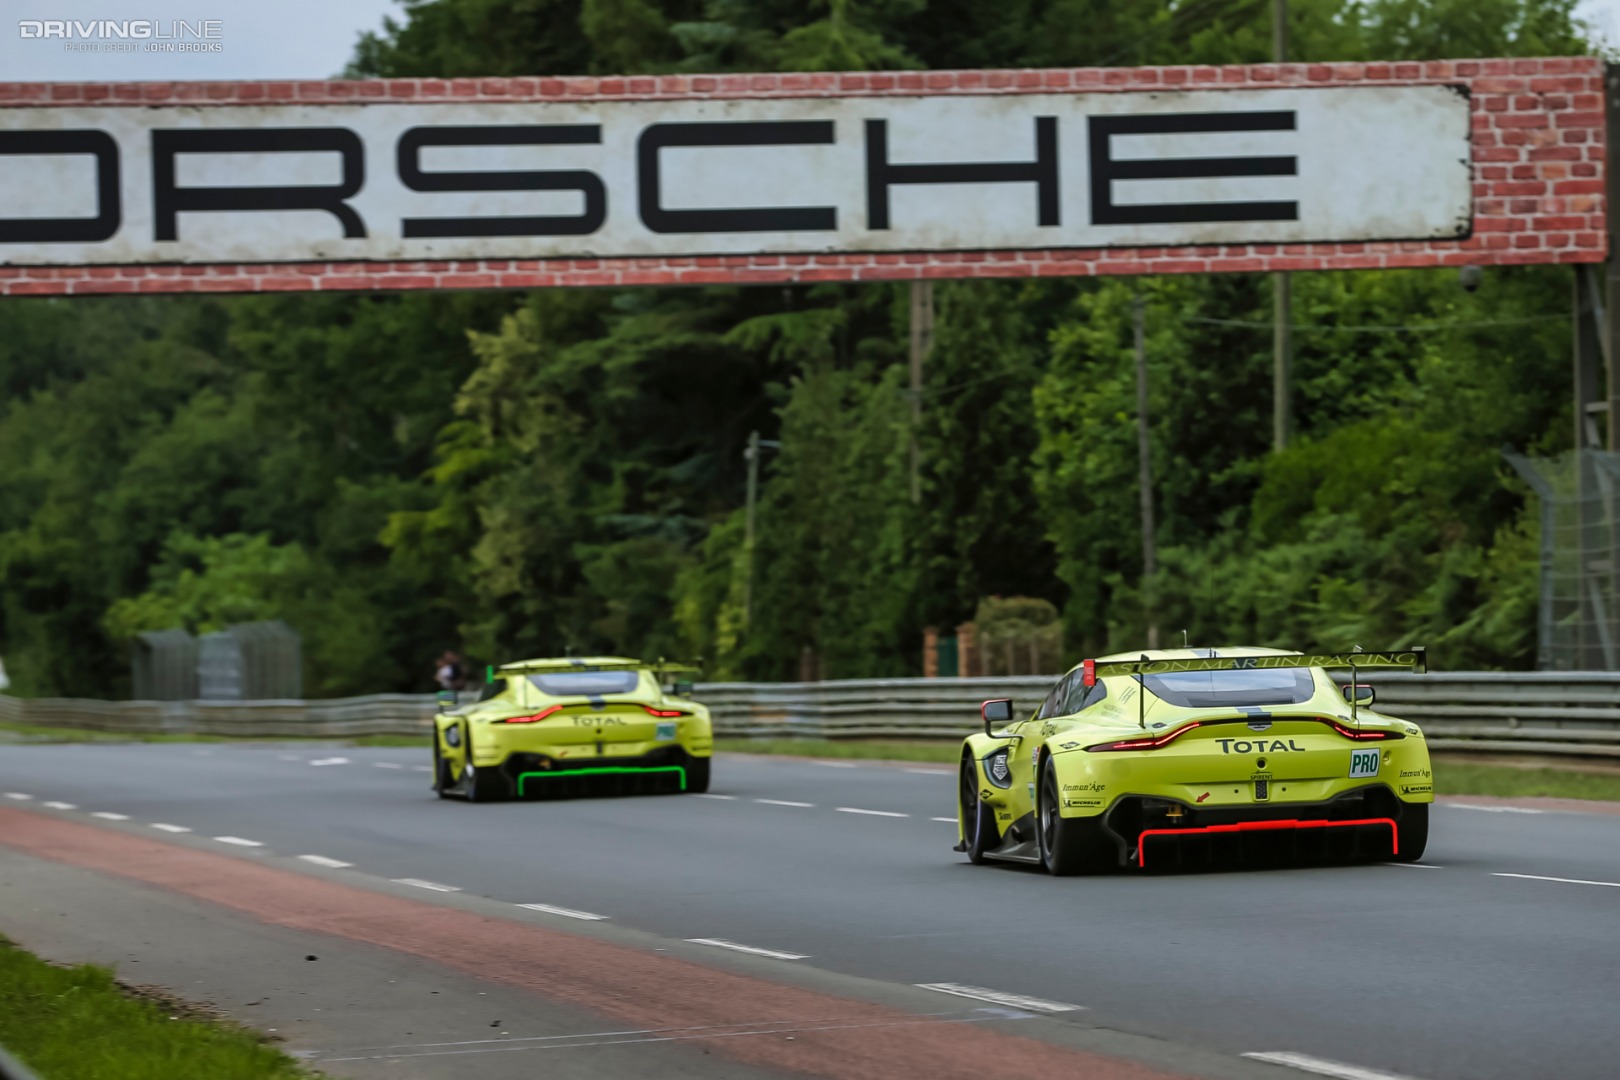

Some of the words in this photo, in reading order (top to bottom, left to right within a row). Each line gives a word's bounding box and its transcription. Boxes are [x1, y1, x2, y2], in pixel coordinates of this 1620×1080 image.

[1100, 660, 1191, 675] ASTON
[1199, 656, 1302, 670] MARTIN
[1308, 652, 1417, 666] RACING
[1351, 753, 1379, 774] PRO
